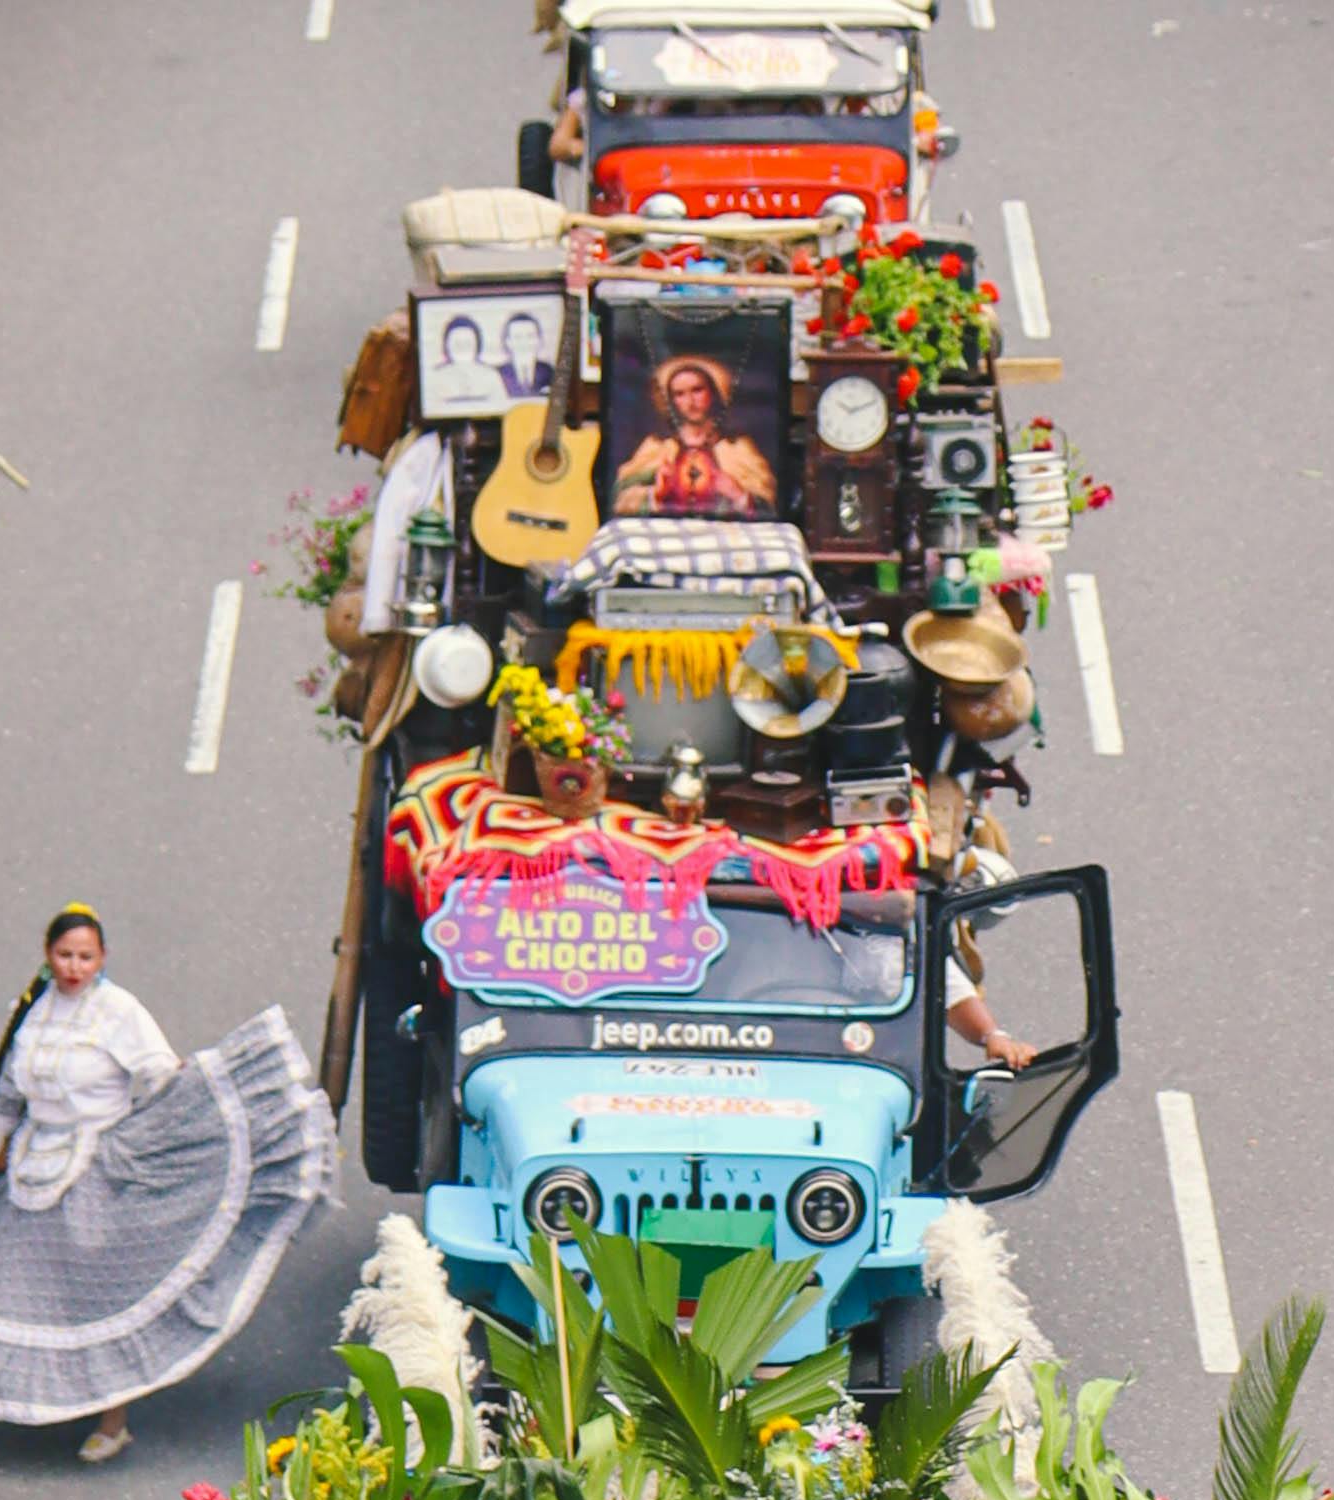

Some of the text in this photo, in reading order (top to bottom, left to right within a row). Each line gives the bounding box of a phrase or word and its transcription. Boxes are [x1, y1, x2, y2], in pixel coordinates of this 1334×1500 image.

[496, 908, 658, 942] ALTO DEL
[505, 940, 648, 972] CHOCHO
[592, 1015, 774, 1050] jeep.com.co
[627, 1168, 761, 1183] WILLYS
